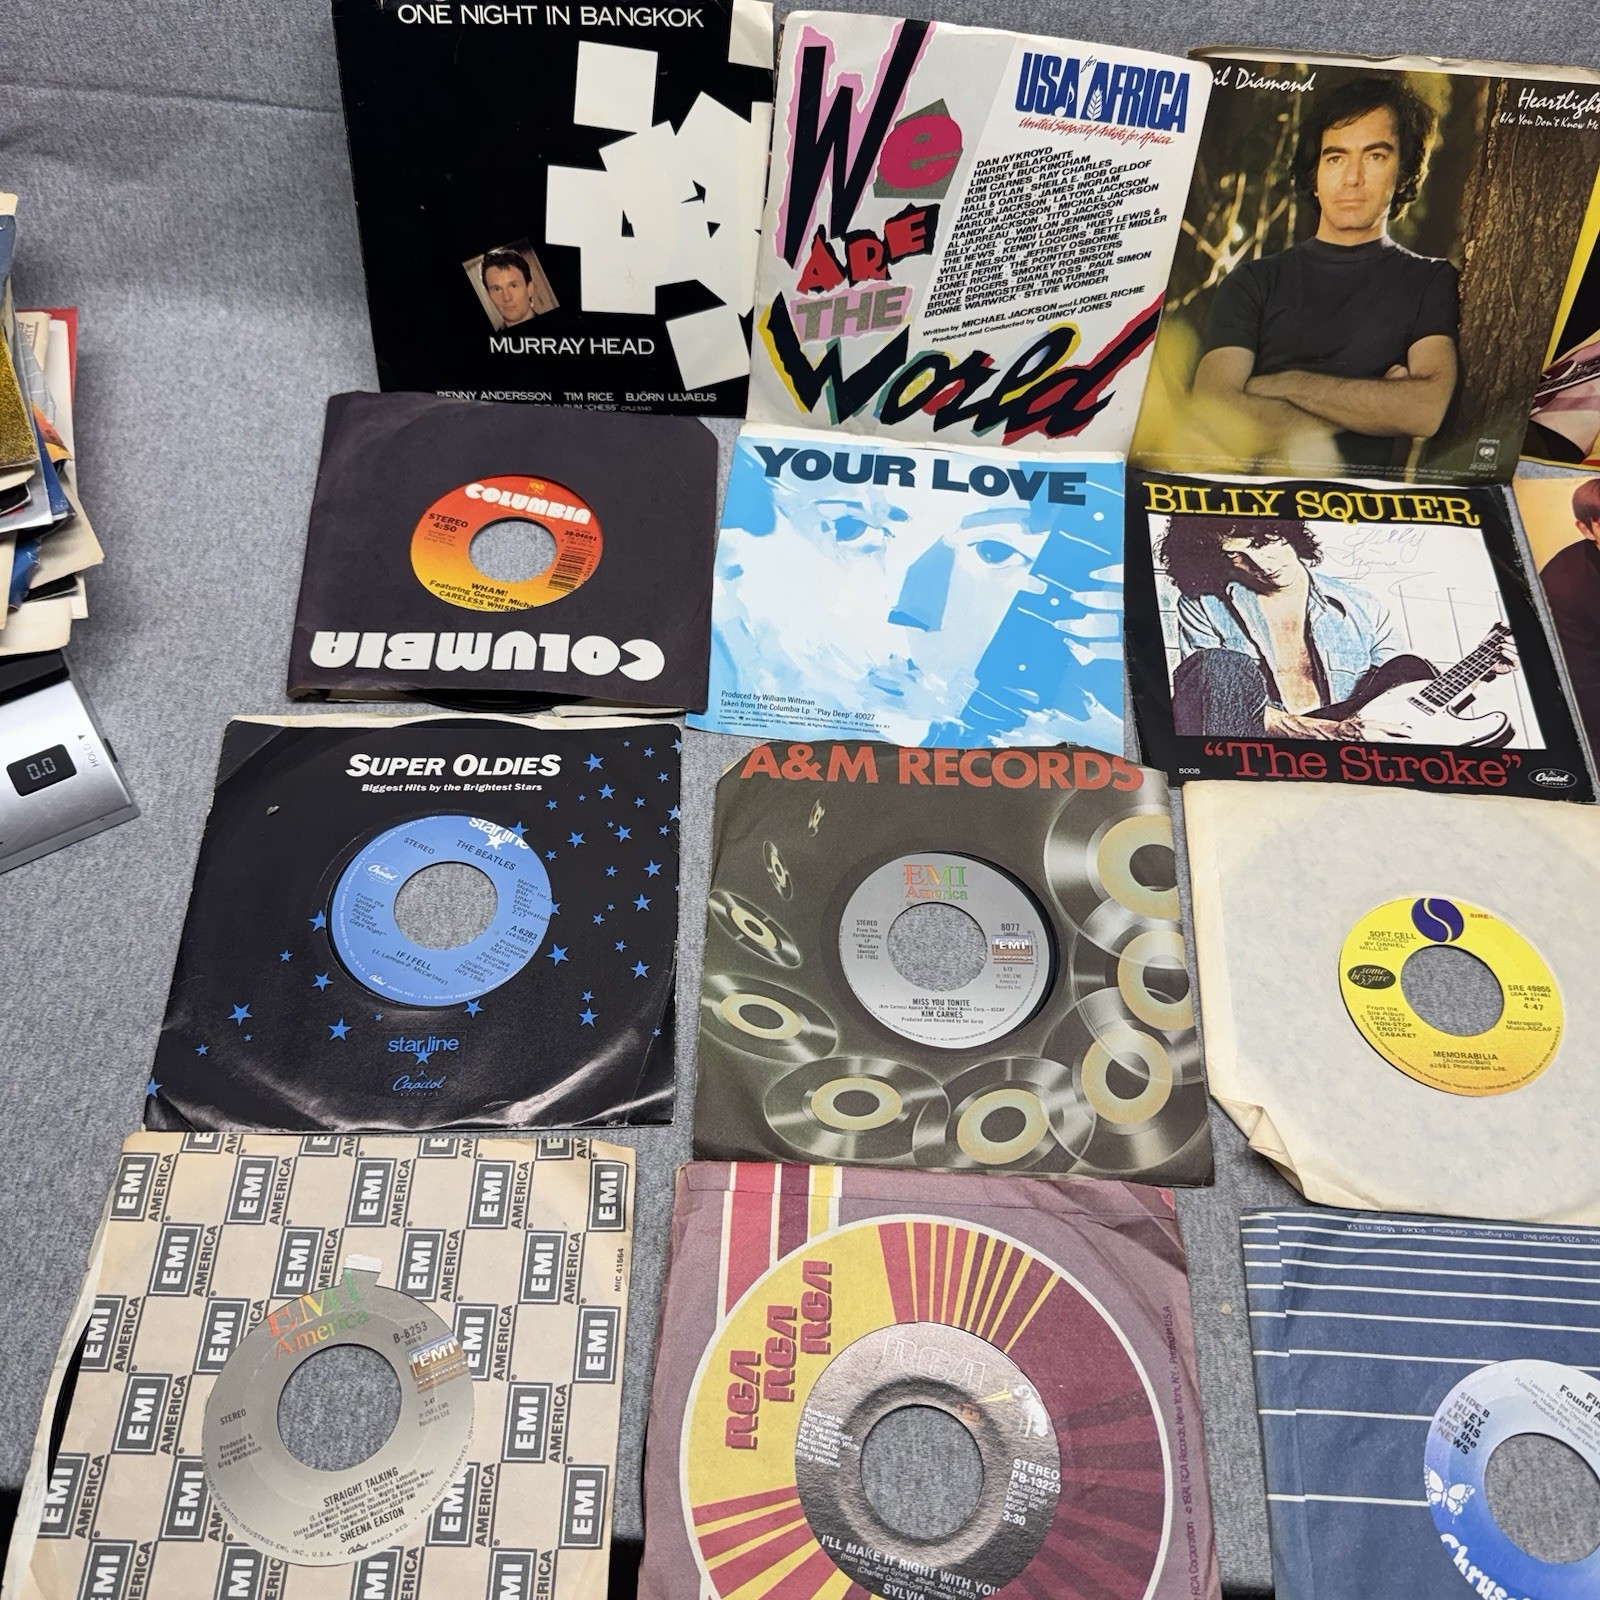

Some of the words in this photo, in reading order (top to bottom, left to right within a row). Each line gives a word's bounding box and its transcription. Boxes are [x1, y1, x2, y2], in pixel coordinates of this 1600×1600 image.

[398, 4, 453, 24] ONE
[460, 5, 538, 25] NIGHT
[546, 5, 570, 25] IN
[580, 6, 704, 27] BANGKOK
[1080, 55, 1096, 73] for
[1015, 52, 1080, 118] USA
[1080, 62, 1190, 133] AFRICA
[1235, 67, 1317, 93] Diamond
[1518, 87, 1600, 119] Heartlight
[1018, 117, 1054, 131] United
[1053, 118, 1088, 139] Support
[1095, 125, 1125, 141] Artists
[1136, 132, 1175, 149] Africa
[1518, 114, 1533, 125] You
[1535, 115, 1559, 127] Don't
[1561, 117, 1584, 129] Know
[1587, 119, 1599, 130] Me
[784, 19, 962, 269] We
[974, 164, 1010, 178] HARRY
[1012, 150, 1073, 170] BELAFONTE
[976, 159, 1000, 168] DAN
[1001, 147, 1053, 164] AYKROYD
[797, 211, 926, 294] ARE
[796, 286, 907, 340] THE
[923, 327, 950, 337] Written
[950, 325, 960, 334] by
[961, 314, 1006, 329] MICHAEL
[1008, 303, 1058, 319] JACKSON
[1058, 302, 1073, 310] and
[1073, 293, 1109, 306] LIONEL
[1110, 286, 1146, 299] RICHIE
[489, 336, 585, 355] MURRAY
[590, 338, 655, 355] HEAD
[767, 291, 1162, 438] World
[480, 391, 552, 401] ANDERSSON
[564, 392, 584, 402] TIM
[587, 392, 615, 402] RICE
[625, 391, 664, 402] BJÖRN
[668, 393, 717, 402] ULVAEUS
[753, 446, 916, 488] YOUR
[932, 459, 1087, 506] LOVE
[465, 483, 592, 525] COLUMBIA
[1141, 482, 1285, 516] BILLY
[1296, 490, 1481, 526] SQUIER
[428, 513, 469, 528] STEREO
[433, 522, 457, 533] 4:50
[429, 580, 471, 596] Featuring
[473, 591, 506, 604] George
[508, 598, 534, 608] Micha
[438, 590, 484, 606] CARELESS
[487, 602, 521, 612] WHISP
[471, 582, 508, 597] WHAM!
[310, 630, 665, 681] COLUMBIA
[720, 699, 739, 707] Taken
[740, 700, 756, 709] from
[756, 702, 768, 710] the
[769, 704, 800, 712] Columbia
[802, 706, 810, 714] Lp
[814, 708, 832, 717] "Play
[832, 710, 853, 719] Deep"
[854, 712, 876, 721] 40027
[721, 690, 752, 700] Produced
[753, 692, 760, 700] by
[762, 694, 786, 703] William
[788, 696, 816, 706] Wittman
[26, 757, 57, 781] 0.0
[346, 753, 446, 778] SUPER
[453, 754, 562, 778] OLDIES
[739, 744, 879, 784] A&M
[898, 746, 1144, 792] RECORDS
[1204, 742, 1328, 779] "The
[1339, 745, 1522, 787] Stroke"
[1536, 772, 1569, 783] Capitol
[361, 784, 402, 794] Biggest
[404, 784, 427, 792] Hits
[429, 784, 441, 793] by
[444, 784, 461, 792] the
[463, 783, 512, 792] Brightest
[514, 783, 542, 792] Stars
[404, 837, 435, 855] STEREO
[456, 839, 475, 852] THE
[475, 848, 516, 871] BEATLES
[904, 864, 968, 888] EMI
[905, 886, 968, 900] America
[509, 924, 538, 940] A-6283
[1000, 923, 1020, 932] 8077
[1370, 930, 1392, 938] SOFT
[1394, 932, 1417, 940] CELL
[999, 939, 1030, 950] EMI
[396, 950, 406, 959] IF
[412, 956, 432, 970] FELL
[1360, 967, 1387, 976] some
[912, 998, 930, 1006] MISS
[931, 998, 946, 1006] YOU
[946, 999, 970, 1007] TONITE
[920, 1010, 934, 1018] KIM
[936, 1010, 964, 1018] CARNES
[1374, 1020, 1412, 1028] NON-STOP
[388, 1036, 460, 1052] starline
[1433, 1050, 1498, 1060] MEMORABILIA
[392, 1076, 447, 1092] Capitol
[117, 1162, 147, 1209] EMI
[148, 1154, 175, 1222] AMERICA
[267, 1268, 364, 1338] EMI
[800, 1260, 832, 1355] RCA
[274, 1309, 370, 1360] America
[392, 1321, 428, 1344] B-8253
[418, 1340, 456, 1368] EMI
[763, 1305, 798, 1402] RCA
[879, 1334, 985, 1391] RCA
[725, 1350, 762, 1450] RCA
[1460, 1392, 1483, 1412] SIDE
[1482, 1409, 1490, 1418] B
[1560, 1384, 1593, 1414] Found
[220, 1408, 247, 1426] STEREO
[514, 1396, 539, 1450] EMI
[549, 1384, 568, 1463] AMERICA
[1446, 1407, 1482, 1438] LEWIS
[1454, 1400, 1486, 1427] HUEY
[1436, 1426, 1470, 1454] NEWS
[1438, 1416, 1459, 1433] and
[1460, 1431, 1478, 1448] the
[1010, 1470, 1061, 1494] PB-13223
[1013, 1458, 1060, 1480] STEREO
[324, 1483, 363, 1508] STRAIGHT
[365, 1466, 398, 1488] TALKING
[340, 1522, 372, 1542] SHEENA
[374, 1506, 405, 1528] EASTON
[1002, 1510, 1026, 1526] 3:30
[822, 1534, 842, 1551] I'LL
[846, 1542, 881, 1562] MAKE
[884, 1553, 897, 1566] IT
[899, 1558, 938, 1579] RIGHT
[940, 1570, 972, 1590] WITH
